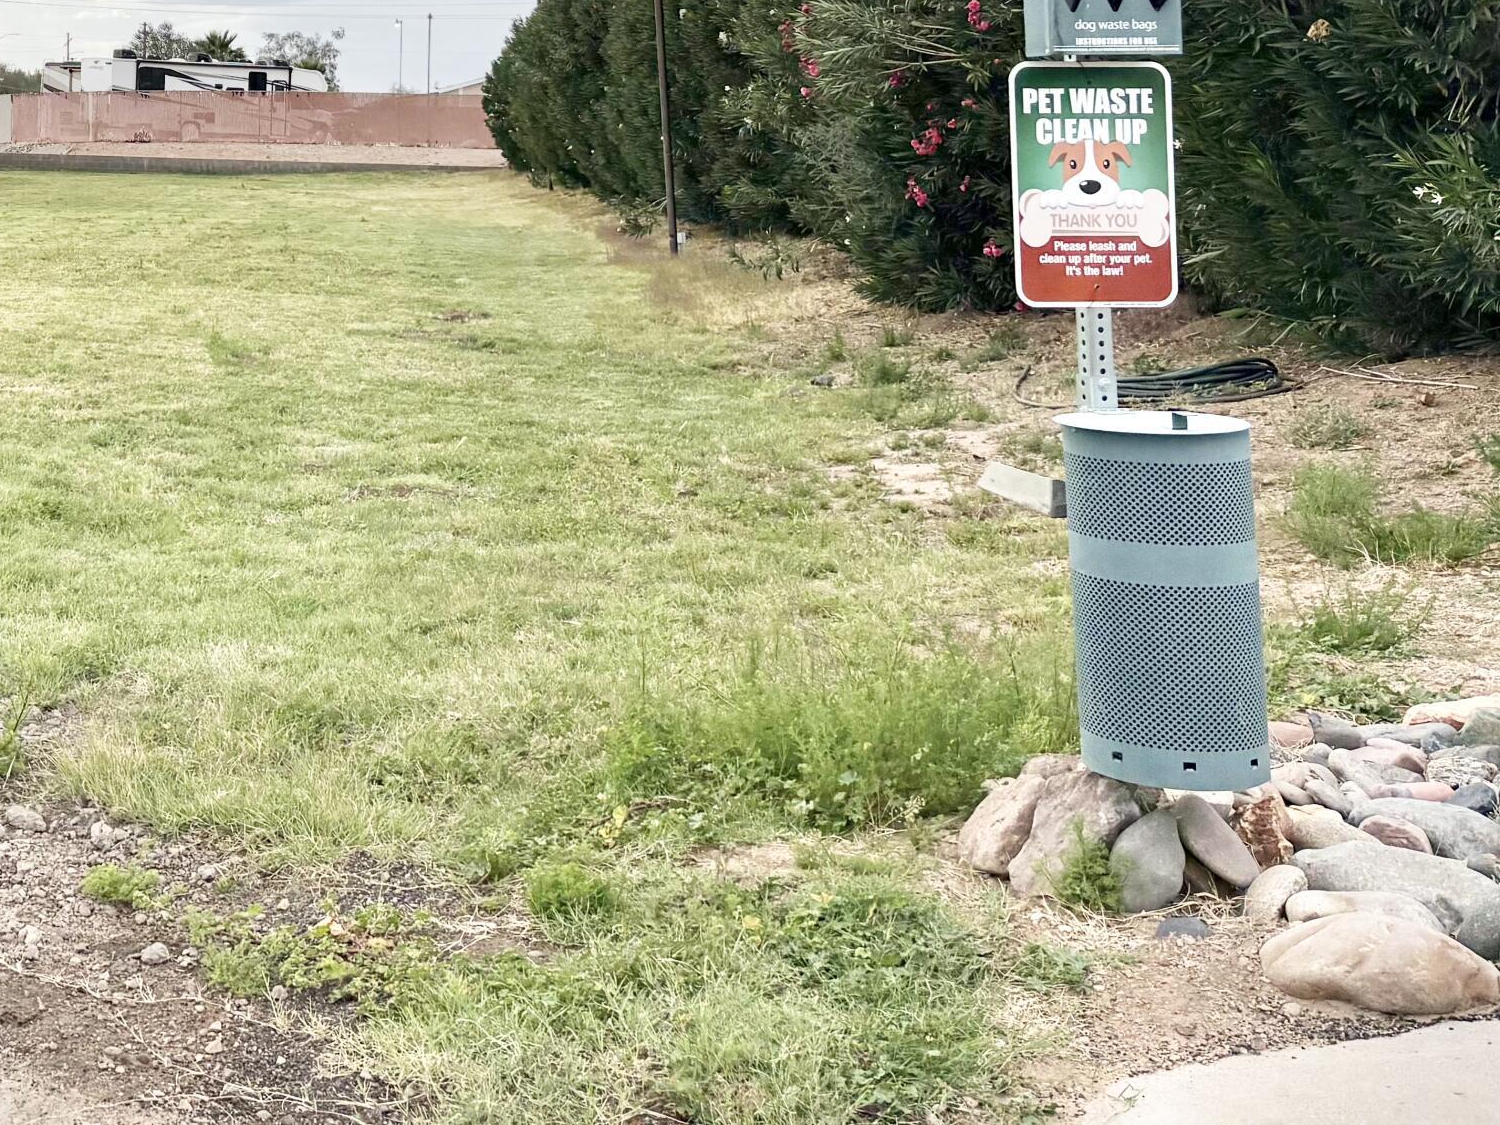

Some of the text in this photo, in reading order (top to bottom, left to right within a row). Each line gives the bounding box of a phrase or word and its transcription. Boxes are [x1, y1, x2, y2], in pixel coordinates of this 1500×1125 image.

[1074, 19, 1158, 32] dog waste bags
[1022, 88, 1154, 114] PET WASTE
[1036, 118, 1148, 145] CLEAN UP
[1050, 214, 1138, 228] THANK YOU
[1054, 241, 1137, 251] Please leash and
[1039, 253, 1153, 265] clean up after your pet.
[1066, 266, 1124, 276] It's the law!
